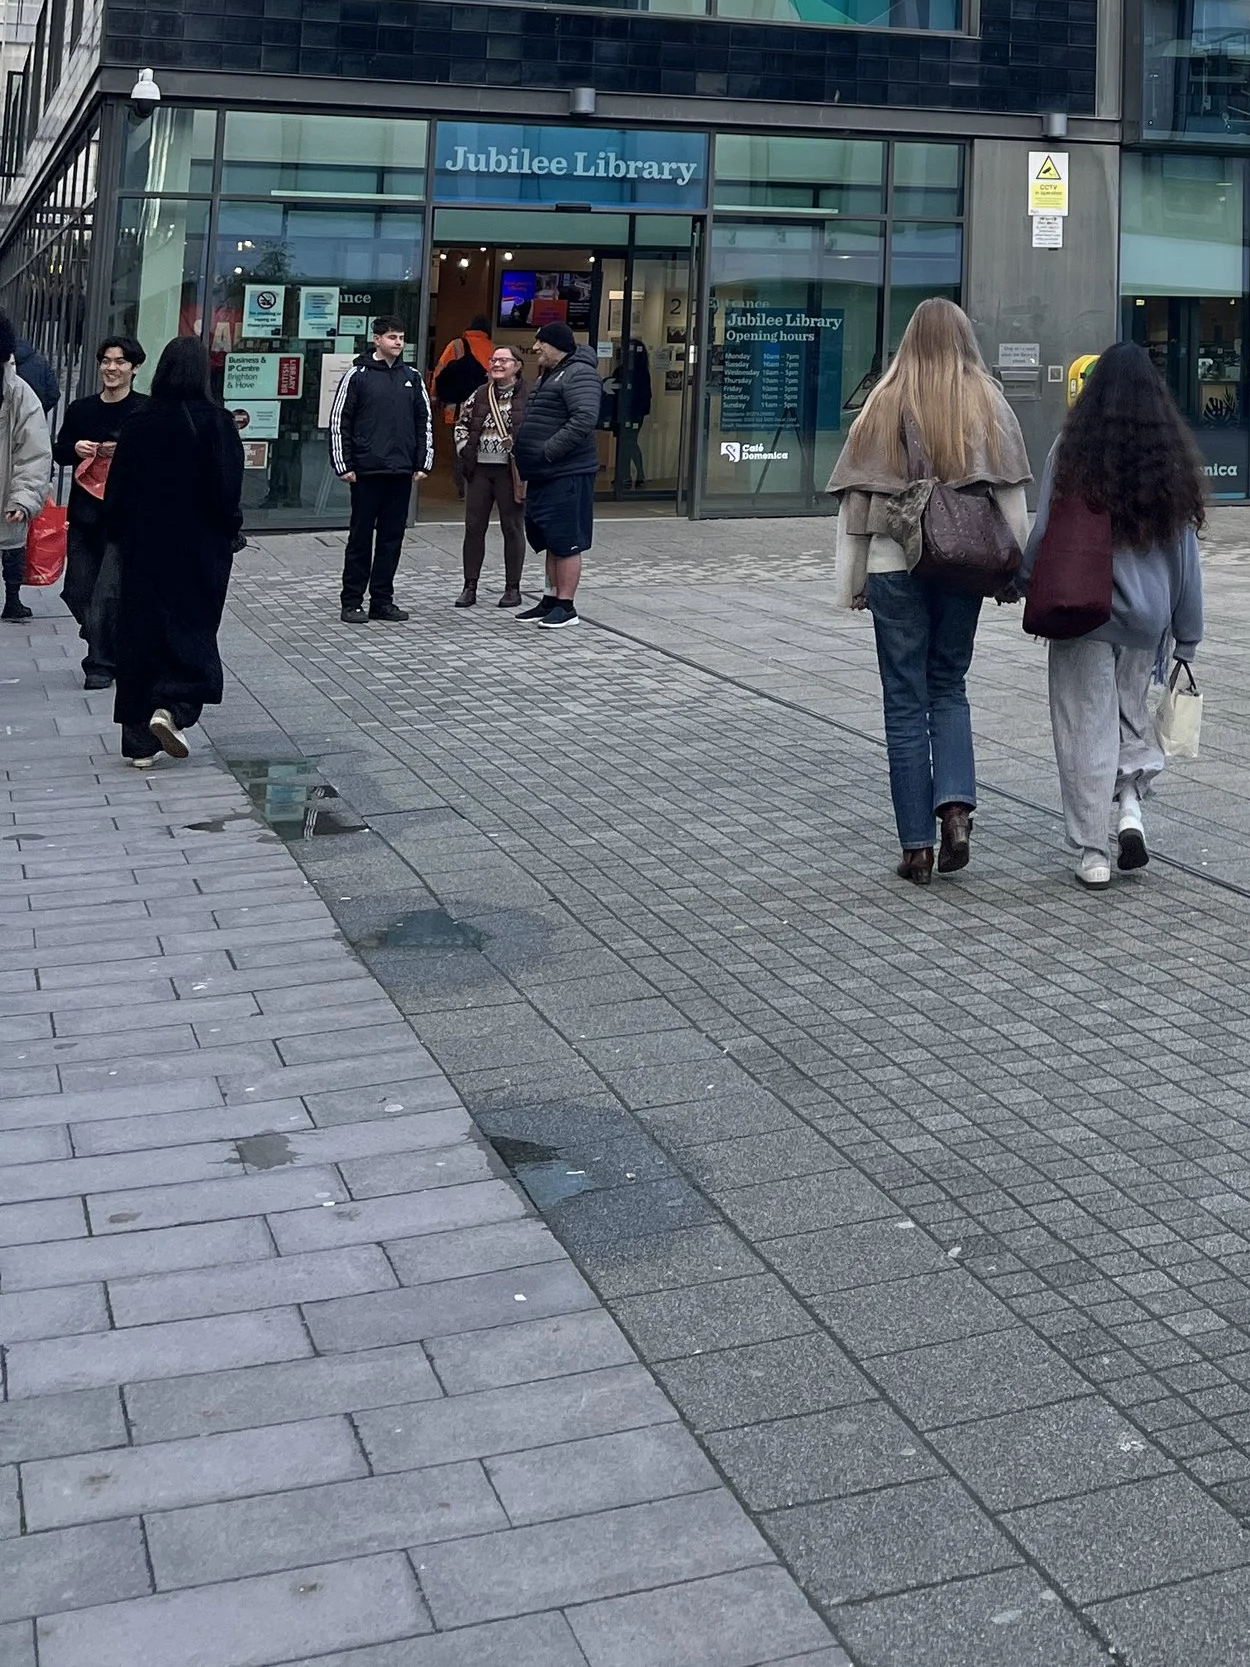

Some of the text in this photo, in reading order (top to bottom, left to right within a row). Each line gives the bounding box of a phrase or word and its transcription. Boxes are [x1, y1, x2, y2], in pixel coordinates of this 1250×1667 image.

[446, 146, 697, 185] Jubilee Library
[670, 299, 681, 315] 2
[727, 313, 843, 330] Jubilee Library
[726, 330, 815, 343] Opening hours
[227, 373, 258, 382] Brighton
[724, 377, 752, 385] Thursday
[742, 443, 764, 452] Café
[741, 451, 788, 460] Domenica
[1204, 463, 1238, 476] nica
